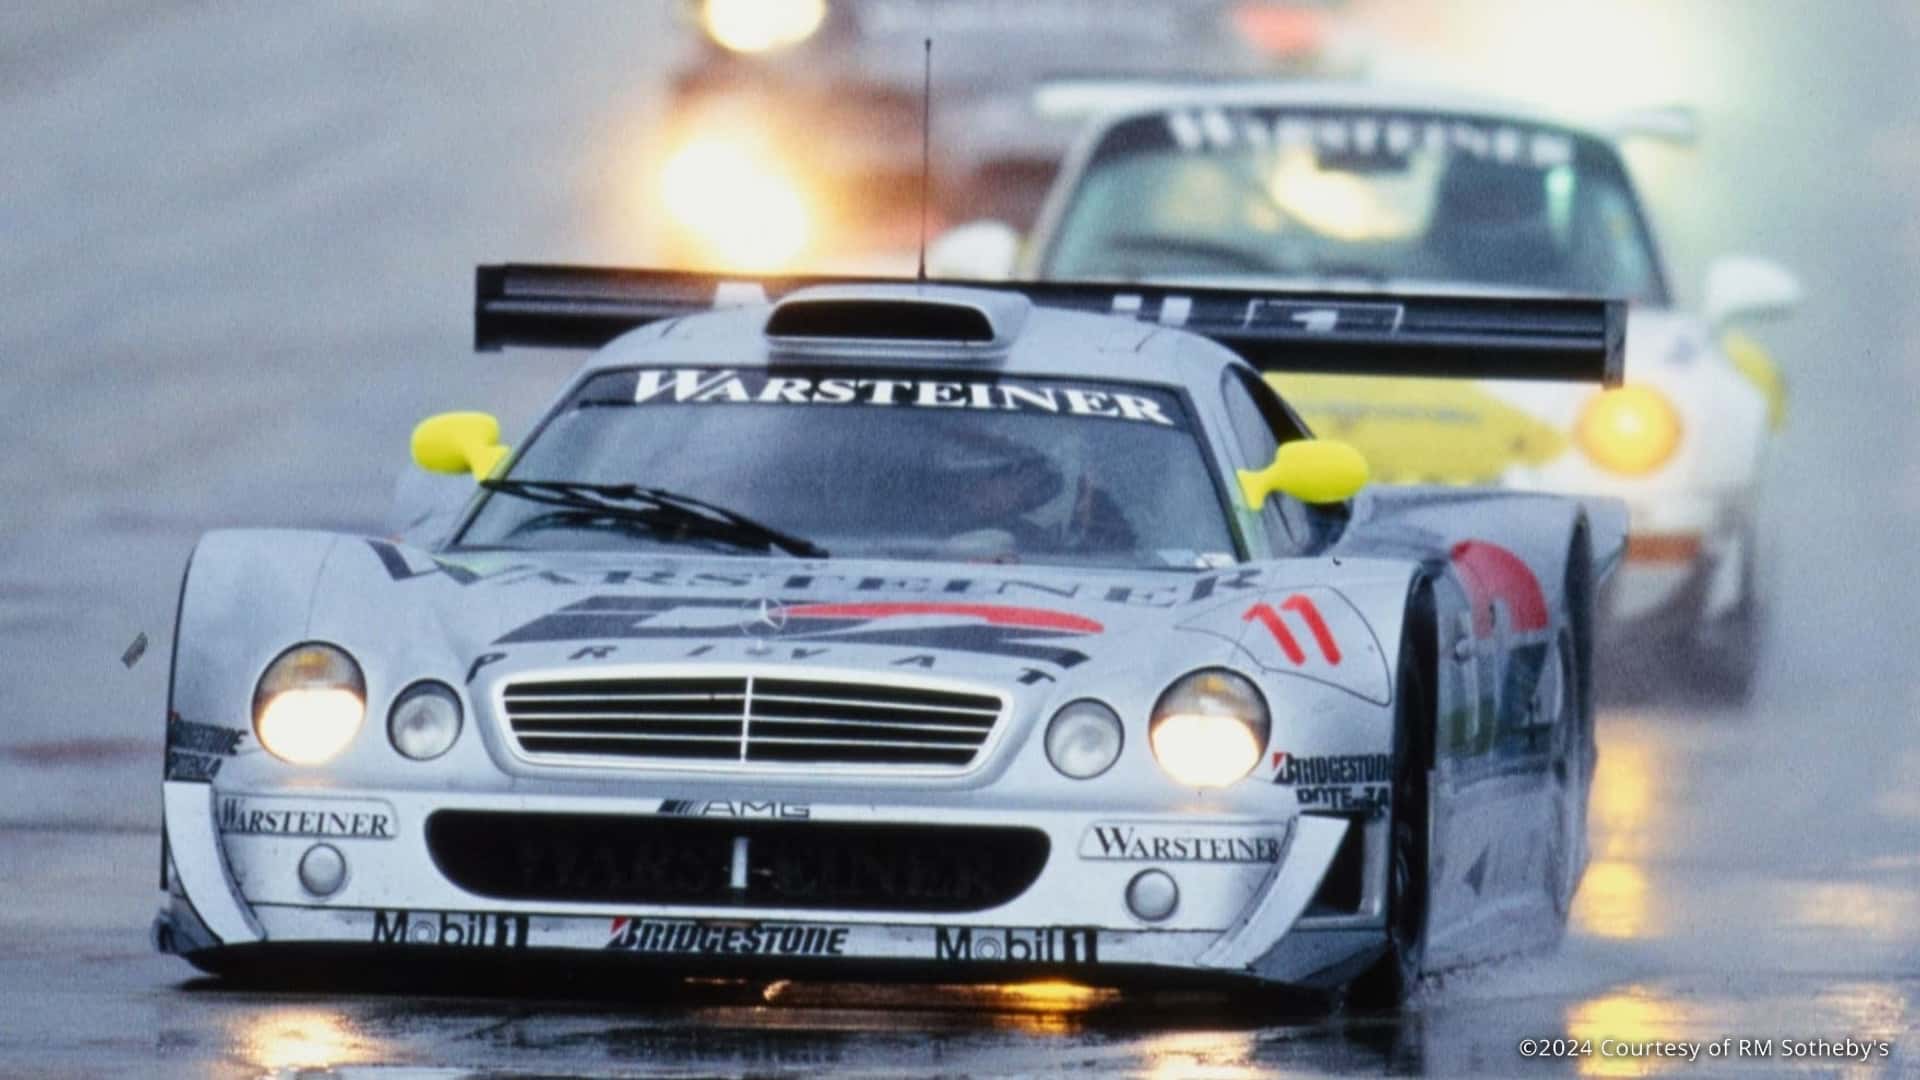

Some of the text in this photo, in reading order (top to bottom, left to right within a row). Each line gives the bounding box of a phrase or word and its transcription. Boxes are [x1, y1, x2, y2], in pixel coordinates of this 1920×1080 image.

[633, 369, 1174, 426] WARSTEINER
[1241, 593, 1342, 667] 11
[221, 798, 389, 837] WARSTEINER
[701, 799, 811, 820] AMG
[1094, 825, 1281, 863] WARSTEINER
[374, 910, 488, 948] Mobil
[606, 914, 850, 955] BRIDGESTONE
[935, 925, 1054, 962] Mobil
